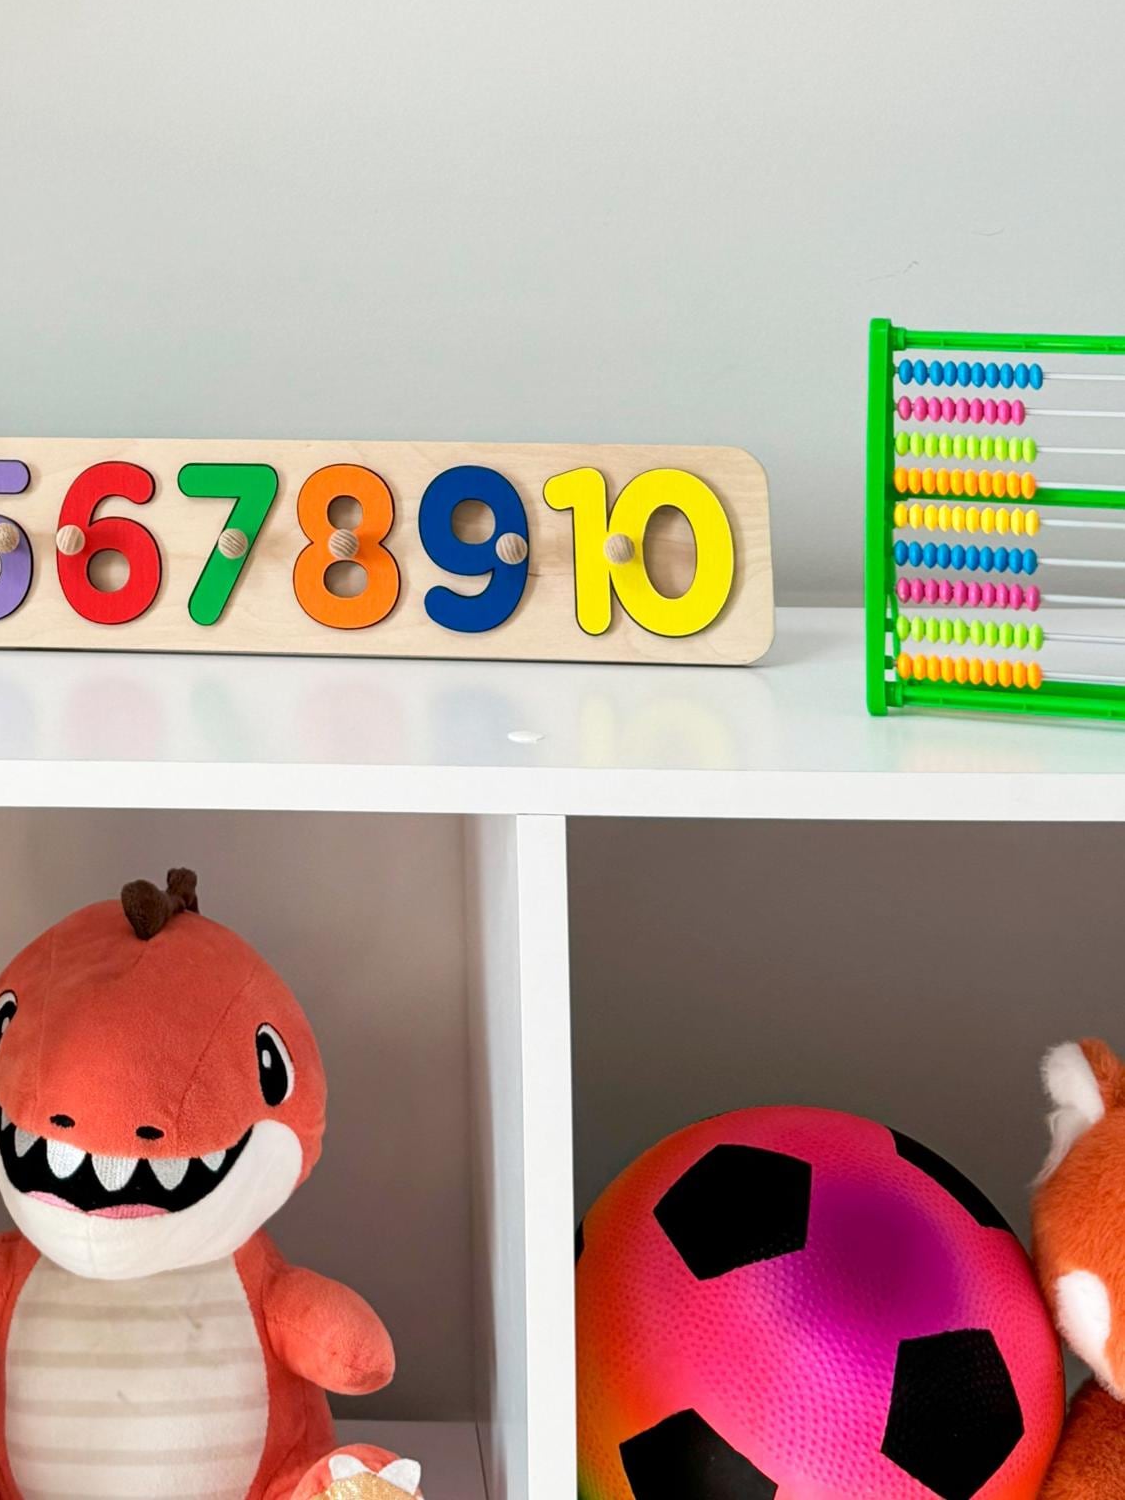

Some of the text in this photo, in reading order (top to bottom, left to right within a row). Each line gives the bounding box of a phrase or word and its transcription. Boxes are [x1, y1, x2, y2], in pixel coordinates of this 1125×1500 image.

[57, 461, 162, 624] 6
[178, 463, 278, 626] 7
[293, 463, 400, 629] 8
[418, 465, 529, 633] 9
[543, 467, 734, 637] 10
